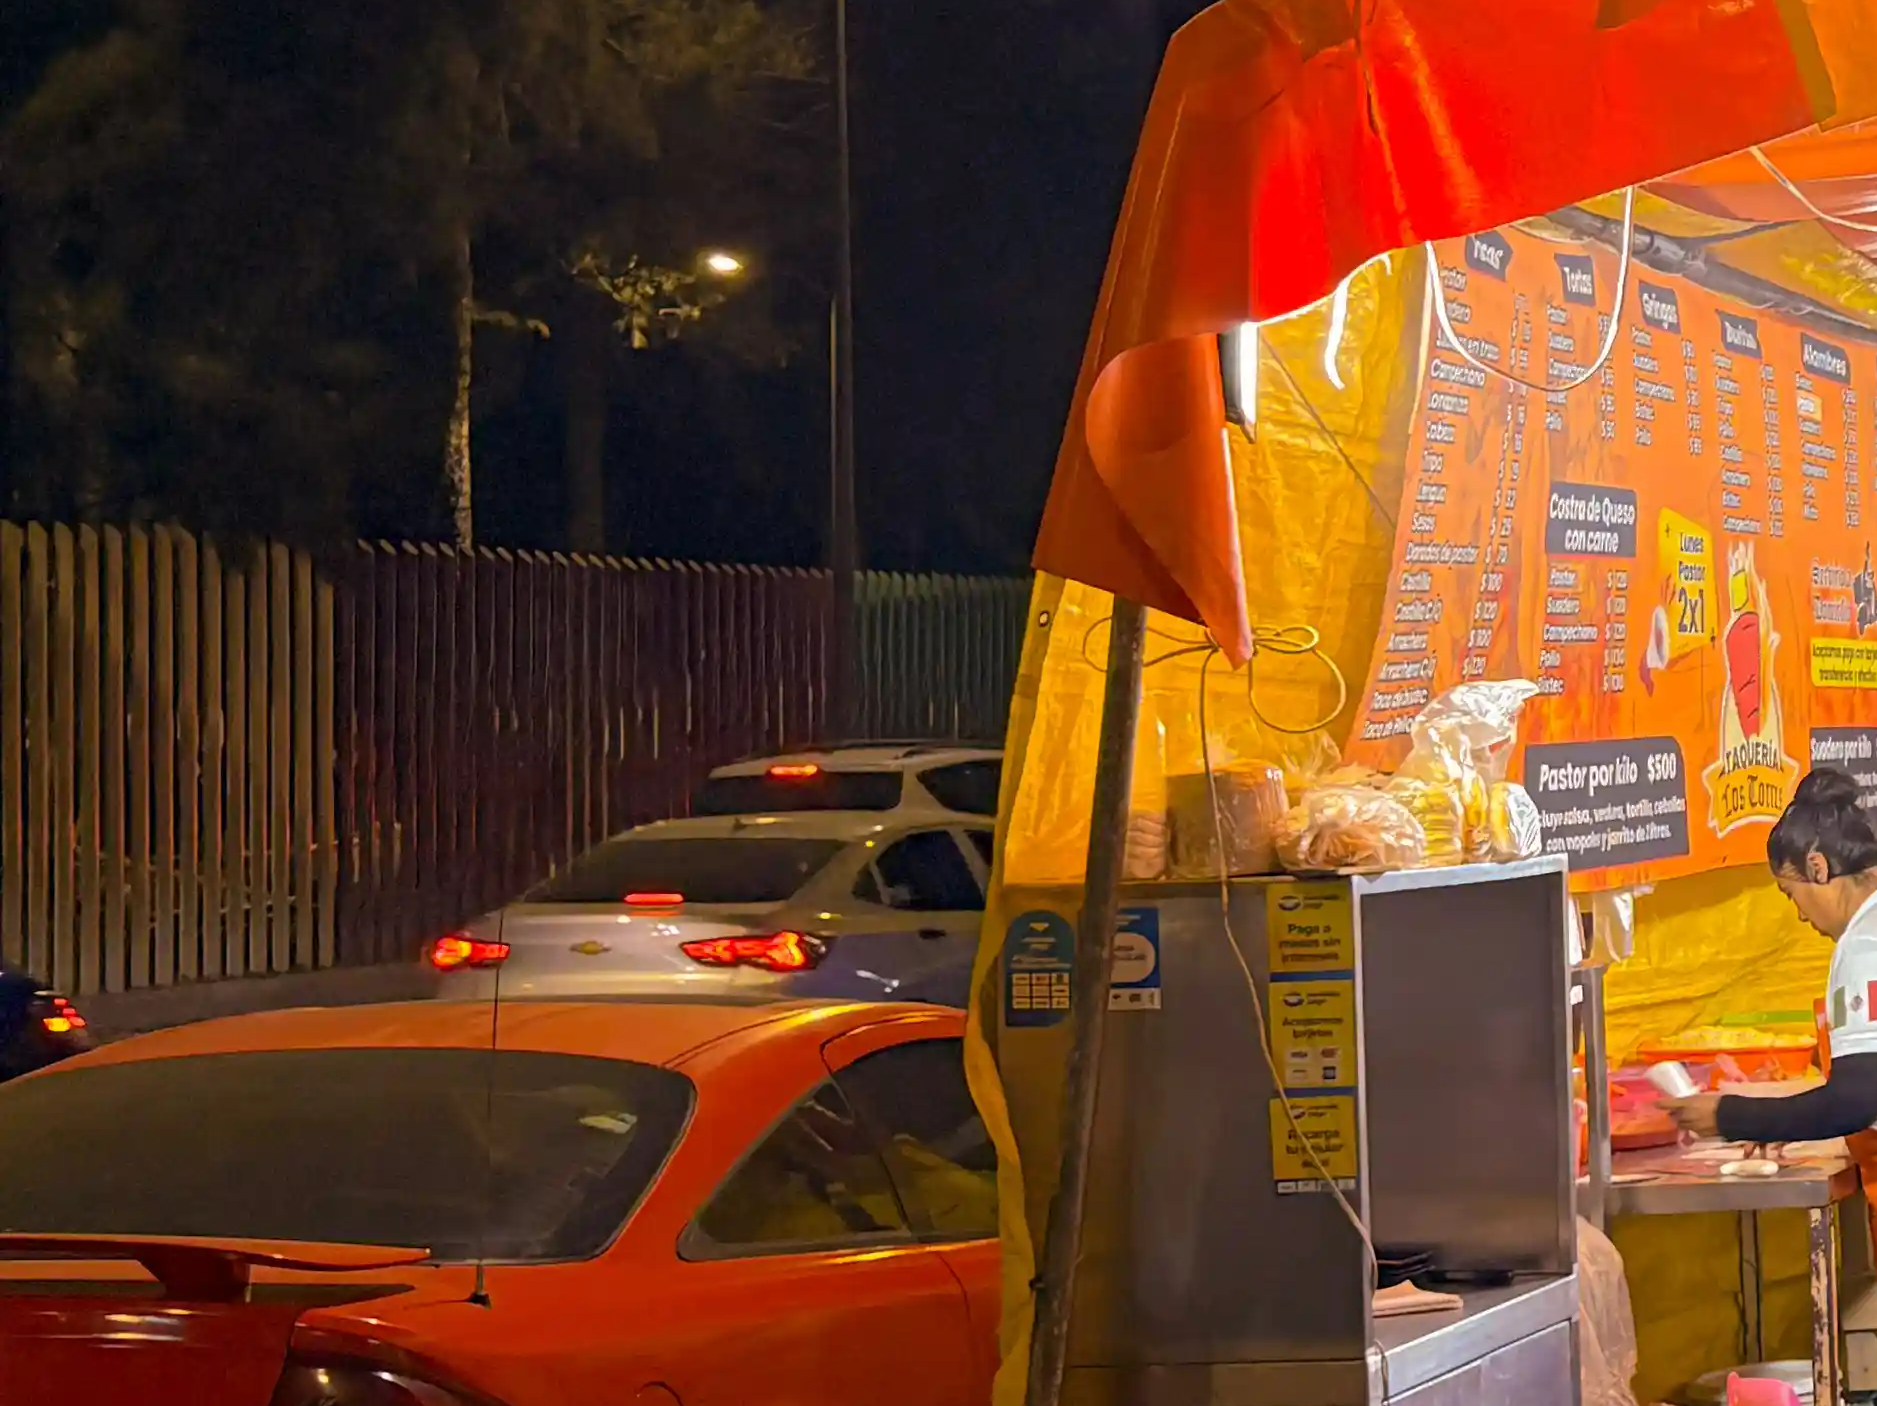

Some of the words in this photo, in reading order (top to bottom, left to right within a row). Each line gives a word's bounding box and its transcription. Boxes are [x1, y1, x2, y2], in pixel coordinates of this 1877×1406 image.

[1803, 342, 1848, 378] Alambres
[1550, 493, 1587, 521] Costra
[1587, 494, 1600, 521] de
[1602, 496, 1636, 527] Queso
[1564, 529, 1586, 552] con
[1587, 530, 1619, 553] carne
[1679, 532, 1705, 554] Lunes
[1678, 560, 1706, 581] Pastor
[1678, 587, 1706, 634] 2x1
[1543, 623, 1599, 644] Campechano
[1539, 763, 1586, 792] Pastor
[1589, 763, 1616, 796] por
[1616, 755, 1638, 785] kilo
[1647, 752, 1677, 784] $500
[1721, 783, 1745, 818] Los
[1546, 834, 1566, 852] con
[1287, 1128, 1341, 1145] Rcarga
